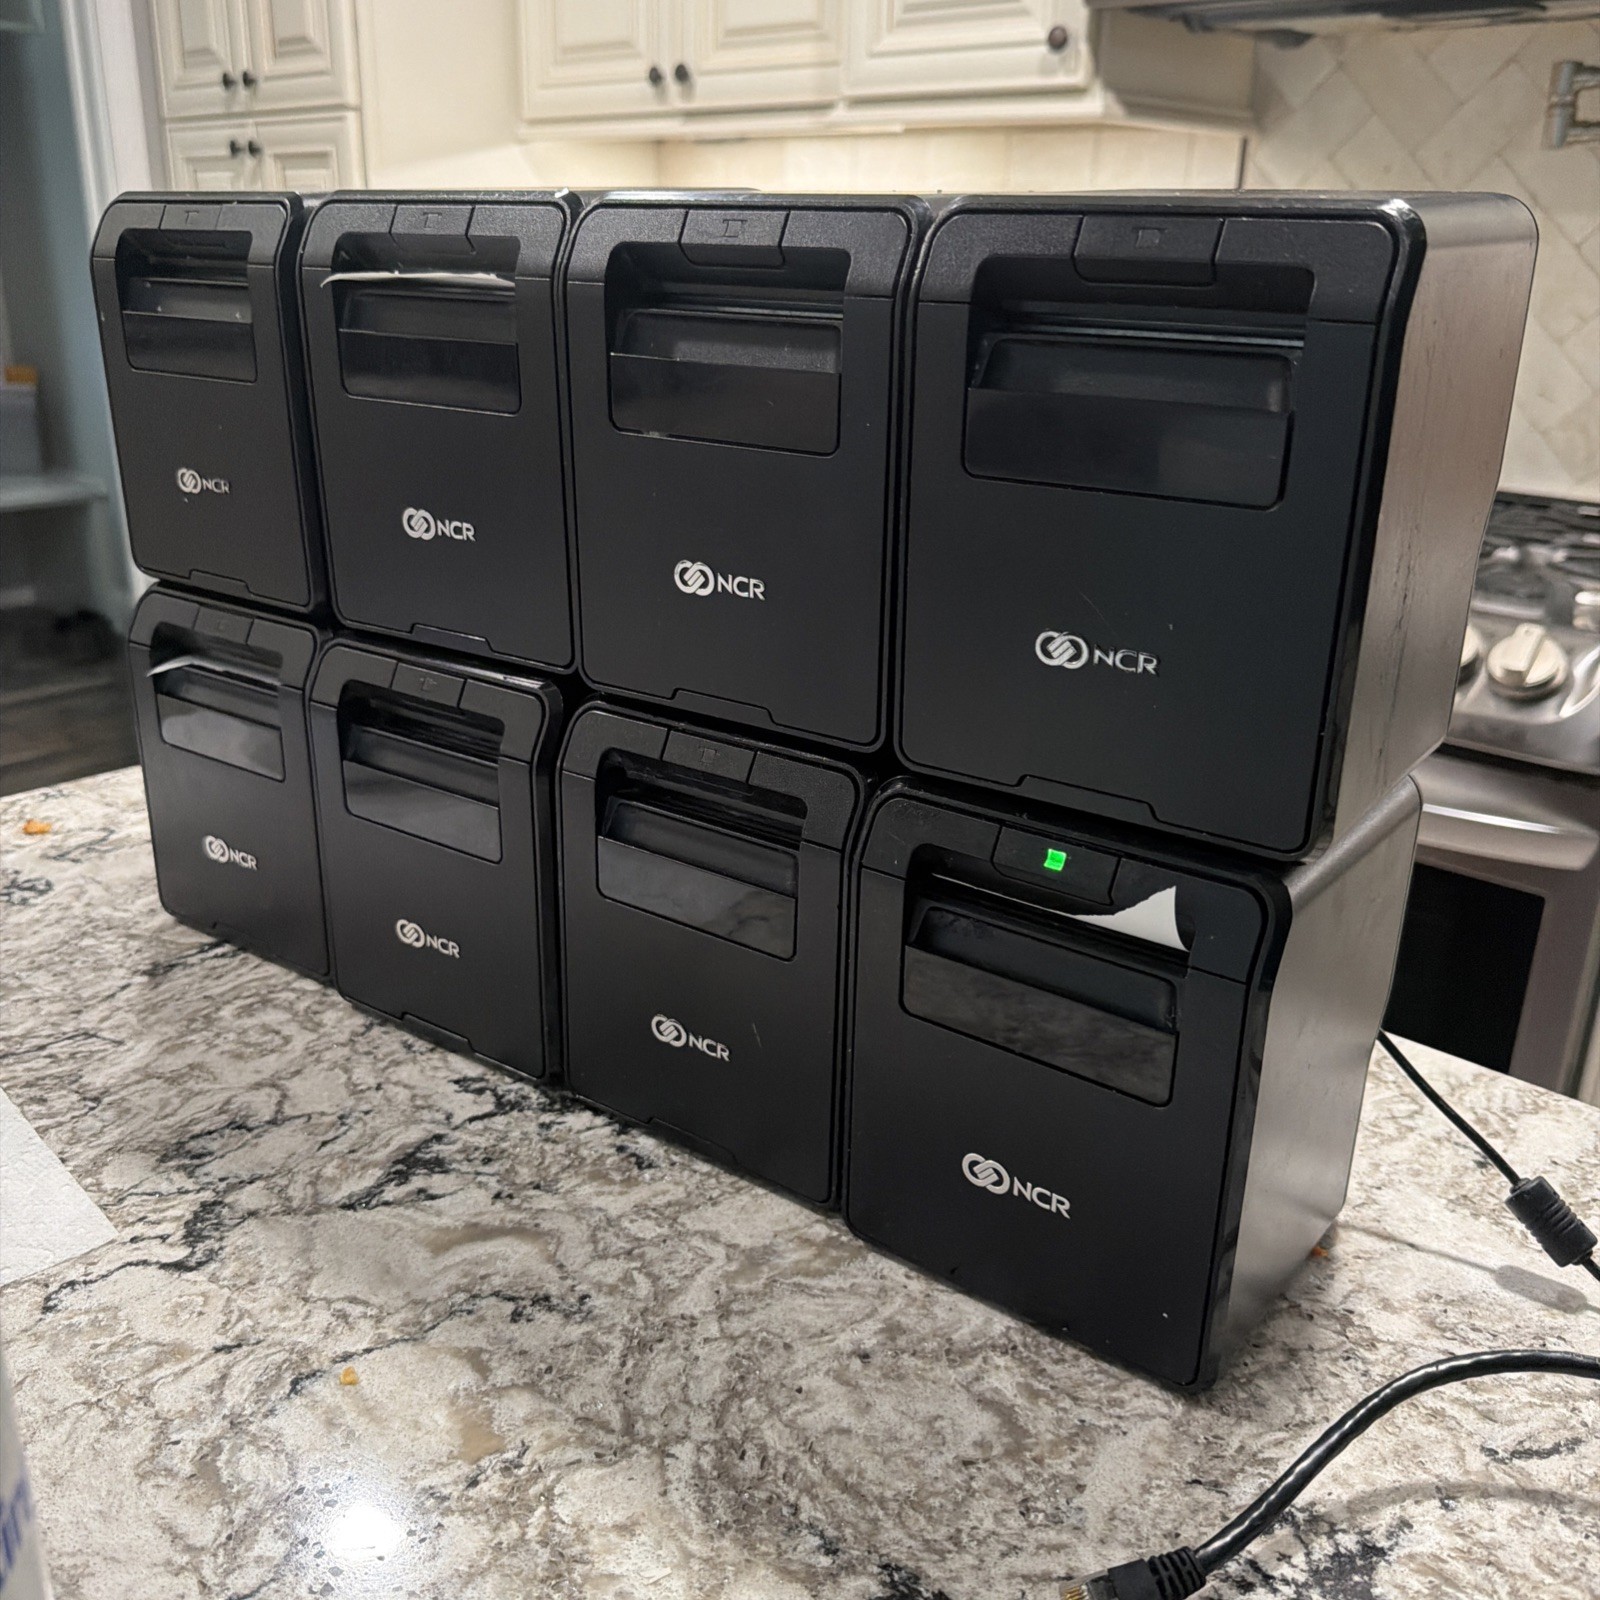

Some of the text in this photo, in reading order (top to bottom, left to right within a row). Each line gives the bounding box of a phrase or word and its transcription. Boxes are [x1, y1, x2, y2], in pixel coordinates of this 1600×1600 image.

[204, 475, 230, 493] NCR
[437, 519, 476, 541] NCR
[717, 573, 766, 600] NCR
[1093, 647, 1158, 675] NCR
[230, 848, 258, 870] NCR
[425, 934, 460, 958] NCR
[688, 1033, 730, 1062] NCR
[1013, 1176, 1071, 1218] NCR
